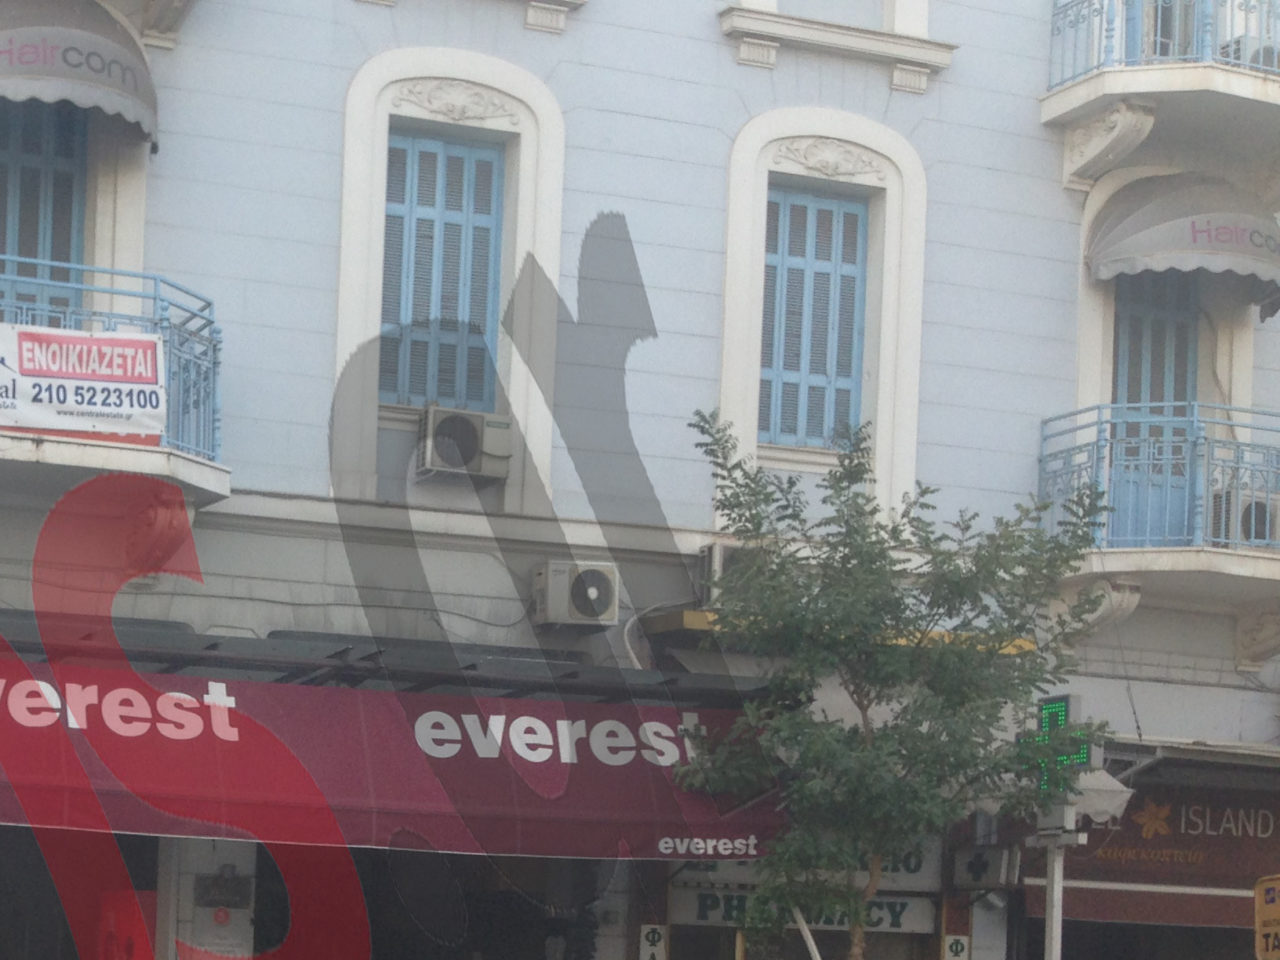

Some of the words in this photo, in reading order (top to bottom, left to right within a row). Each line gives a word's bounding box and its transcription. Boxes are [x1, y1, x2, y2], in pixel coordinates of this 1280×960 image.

[22, 341, 153, 378] ΕΝΟΙΚΙΑΖΕΤΑΙ
[31, 383, 68, 405] 210
[414, 701, 708, 767] everest
[1180, 804, 1275, 838] ISLAND
[658, 834, 758, 856] everest
